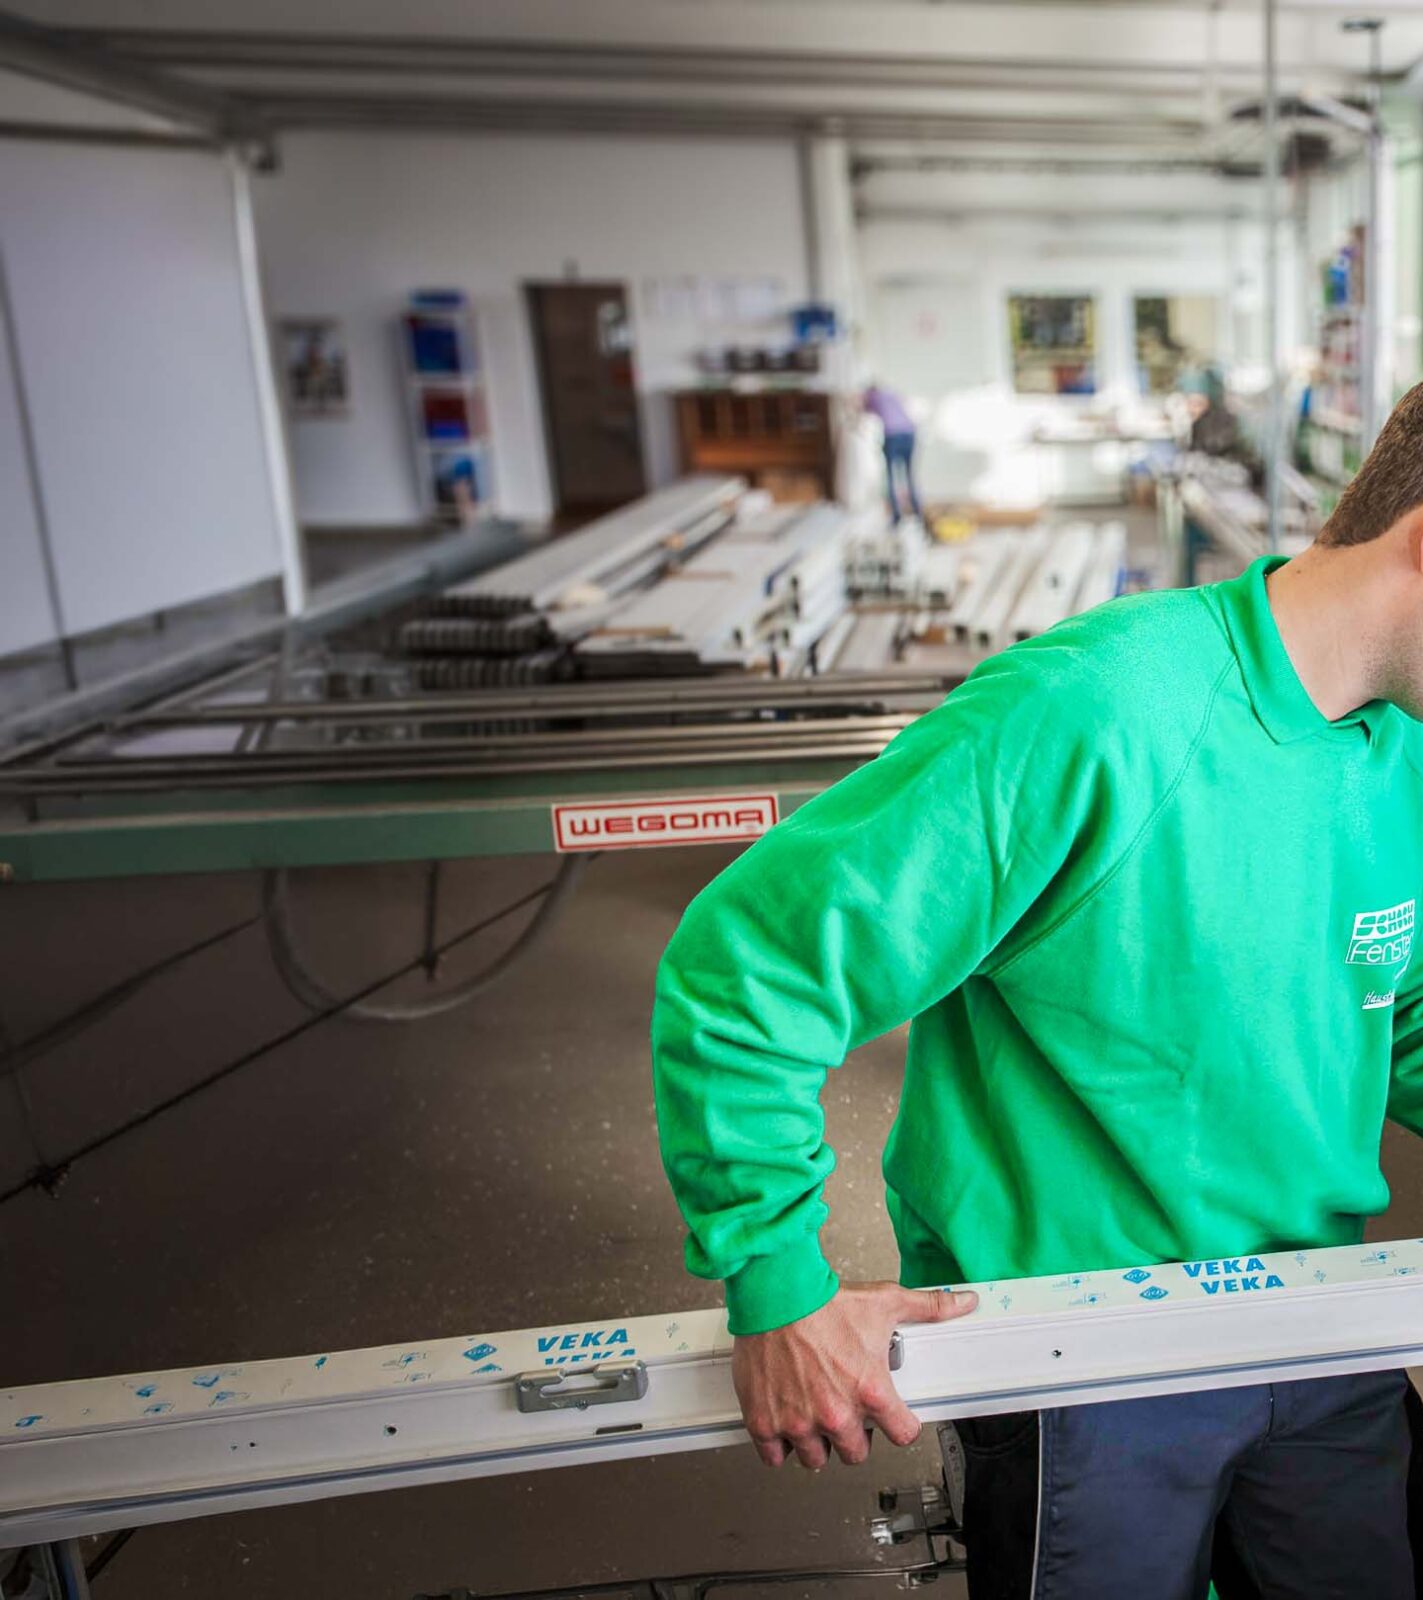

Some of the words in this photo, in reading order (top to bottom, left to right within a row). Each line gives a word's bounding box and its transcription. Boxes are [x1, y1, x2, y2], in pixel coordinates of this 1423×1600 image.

[570, 809, 763, 836] WEGOMA
[1183, 1258, 1266, 1277] VEKA
[1200, 1275, 1285, 1295] VEKA
[538, 1328, 628, 1352] VEKA
